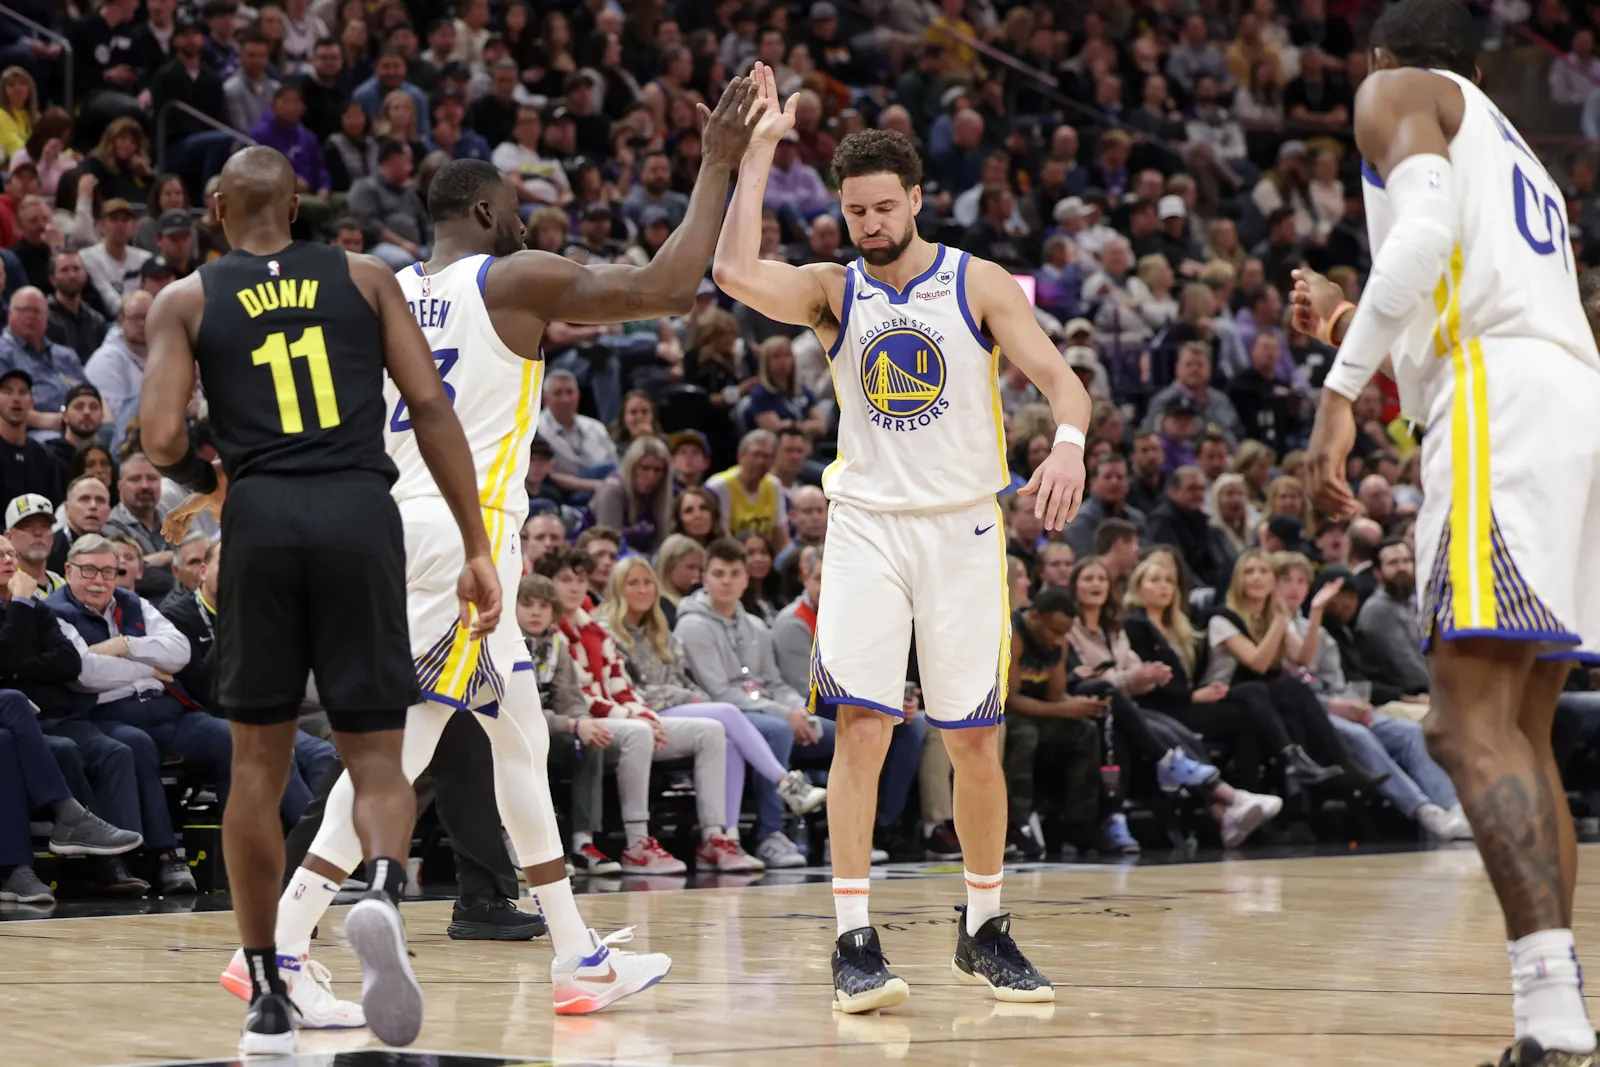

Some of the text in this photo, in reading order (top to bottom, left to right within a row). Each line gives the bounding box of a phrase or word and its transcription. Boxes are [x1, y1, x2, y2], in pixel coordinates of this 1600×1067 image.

[236, 279, 319, 319] DUNN
[916, 290, 951, 300] Rakuten
[860, 318, 945, 345] GOLDEN STATE
[917, 350, 928, 374] 11
[251, 325, 341, 434] 11
[854, 934, 864, 947] 11
